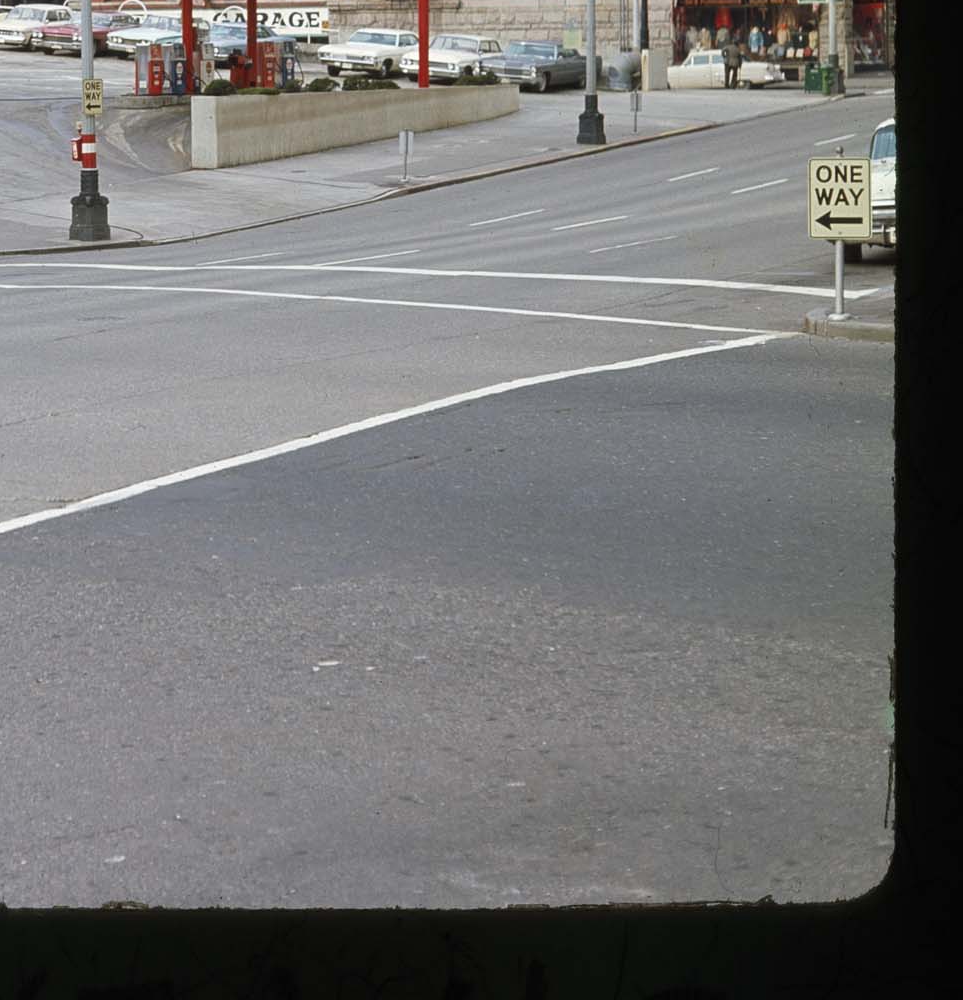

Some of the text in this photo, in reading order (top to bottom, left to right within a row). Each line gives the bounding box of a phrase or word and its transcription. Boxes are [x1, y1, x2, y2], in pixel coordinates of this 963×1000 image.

[85, 82, 101, 91] ONE
[84, 91, 102, 100] WAY
[816, 165, 863, 183] ONE
[815, 188, 865, 206] WAY
